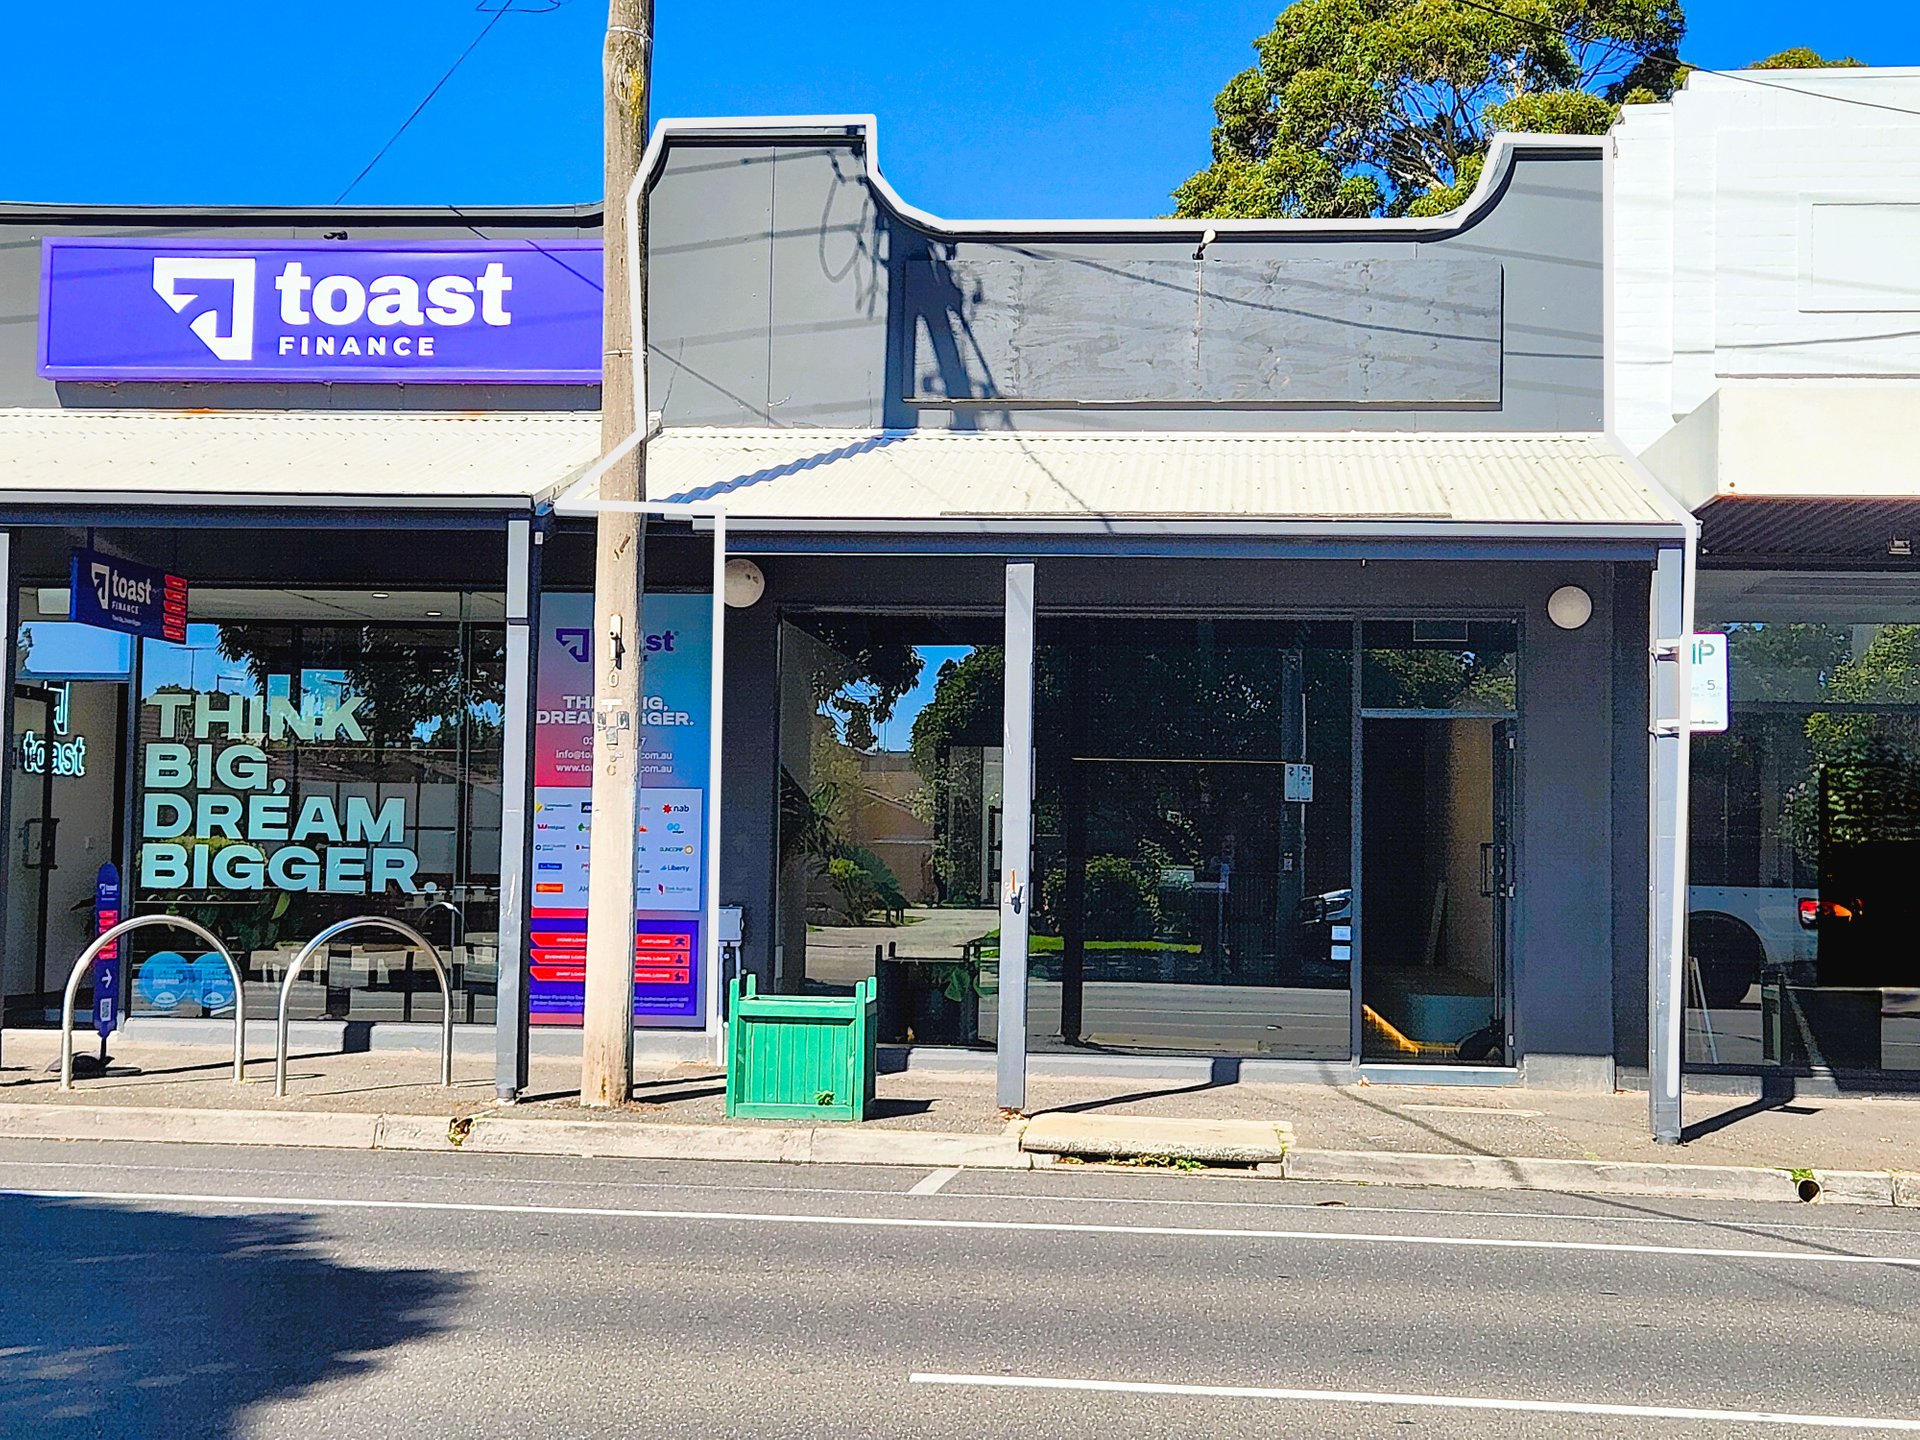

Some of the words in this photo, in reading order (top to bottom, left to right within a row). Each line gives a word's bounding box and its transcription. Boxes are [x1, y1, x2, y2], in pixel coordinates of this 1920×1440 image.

[275, 262, 513, 326] toast
[278, 337, 436, 356] FINANCE
[112, 570, 151, 604] toast
[144, 694, 367, 742] THINK
[536, 710, 594, 724] DREA
[563, 696, 594, 709] THI
[144, 744, 287, 795] BIG,
[143, 793, 406, 843] DREAM
[673, 804, 690, 813] nab
[141, 842, 438, 894] BIGGER.
[667, 864, 690, 873] Liberty
